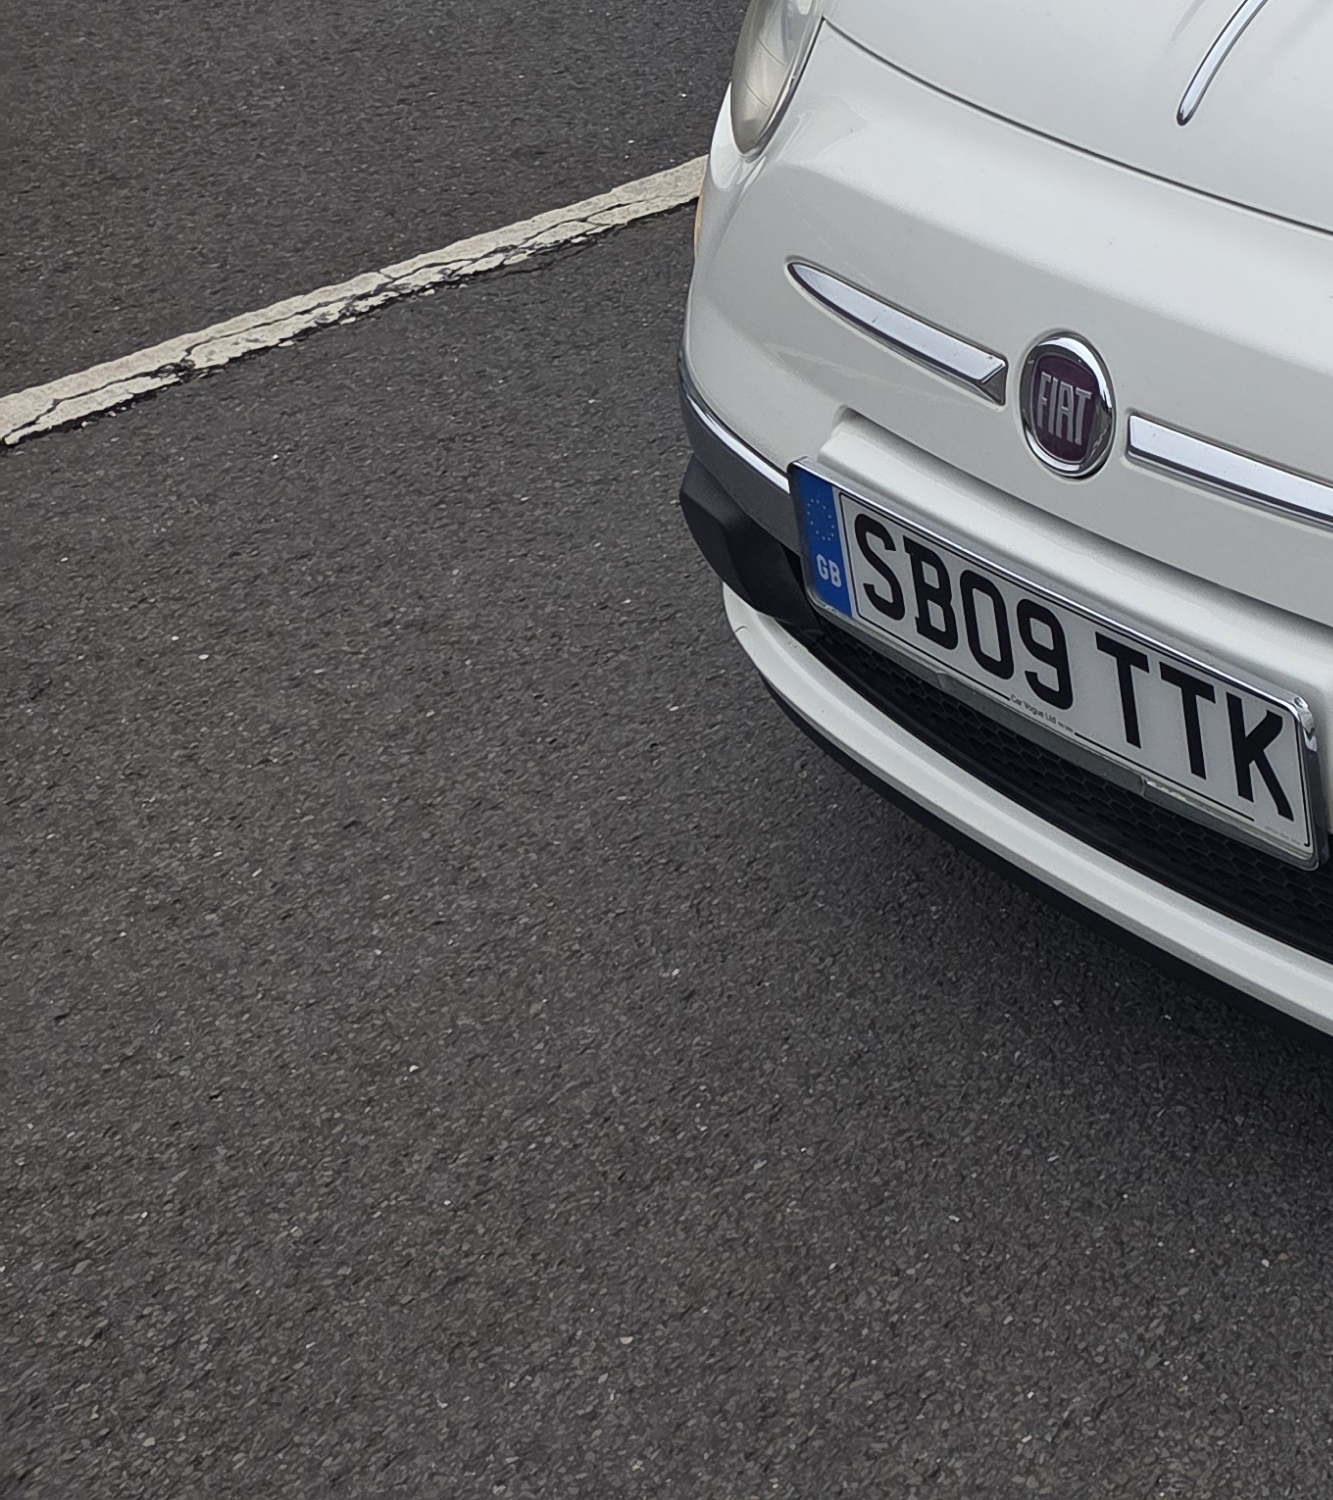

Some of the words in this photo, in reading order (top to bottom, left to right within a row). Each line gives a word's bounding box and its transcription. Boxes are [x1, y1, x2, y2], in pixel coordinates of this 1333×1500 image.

[1036, 371, 1093, 446] FIAT
[816, 554, 842, 588] GB
[853, 513, 1074, 710] SB09
[1094, 630, 1296, 823] TTK
